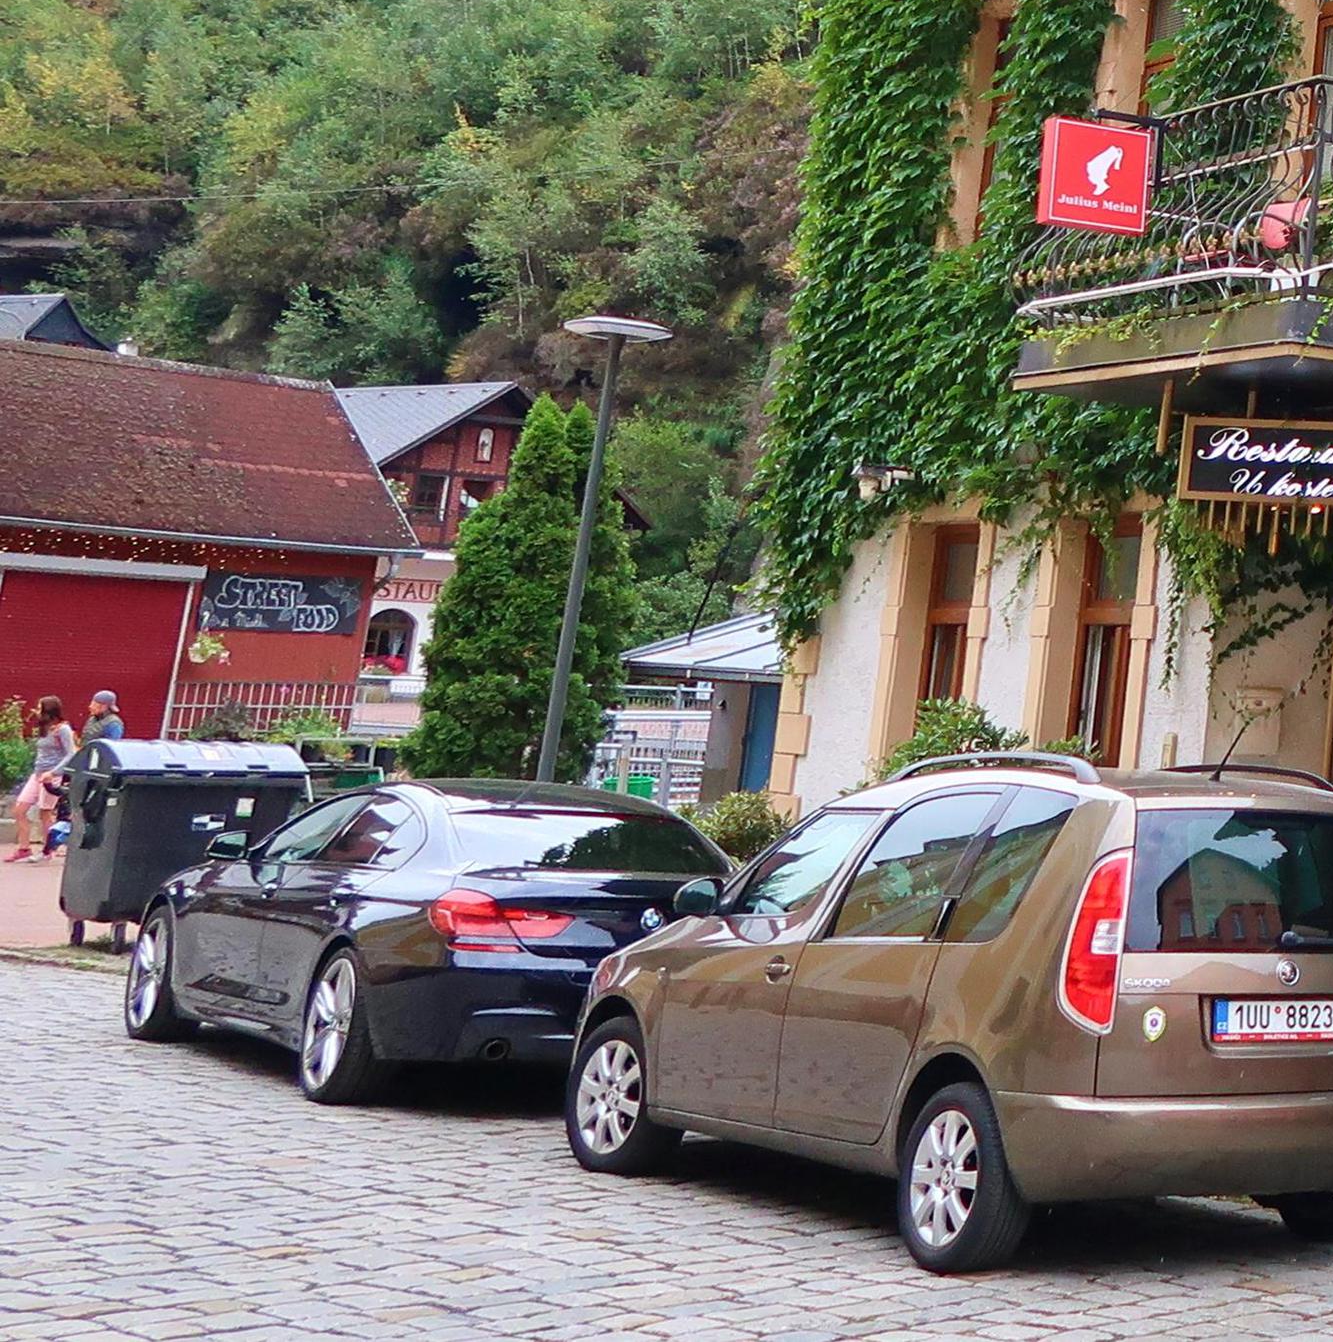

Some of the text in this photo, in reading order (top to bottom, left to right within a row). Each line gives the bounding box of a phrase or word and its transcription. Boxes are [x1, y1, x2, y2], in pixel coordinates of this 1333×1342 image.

[1057, 194, 1138, 214] Julius Meinl
[1229, 468, 1266, 495] U
[215, 575, 303, 609] STREET
[1235, 1004, 1333, 1030] 1UU 8823
